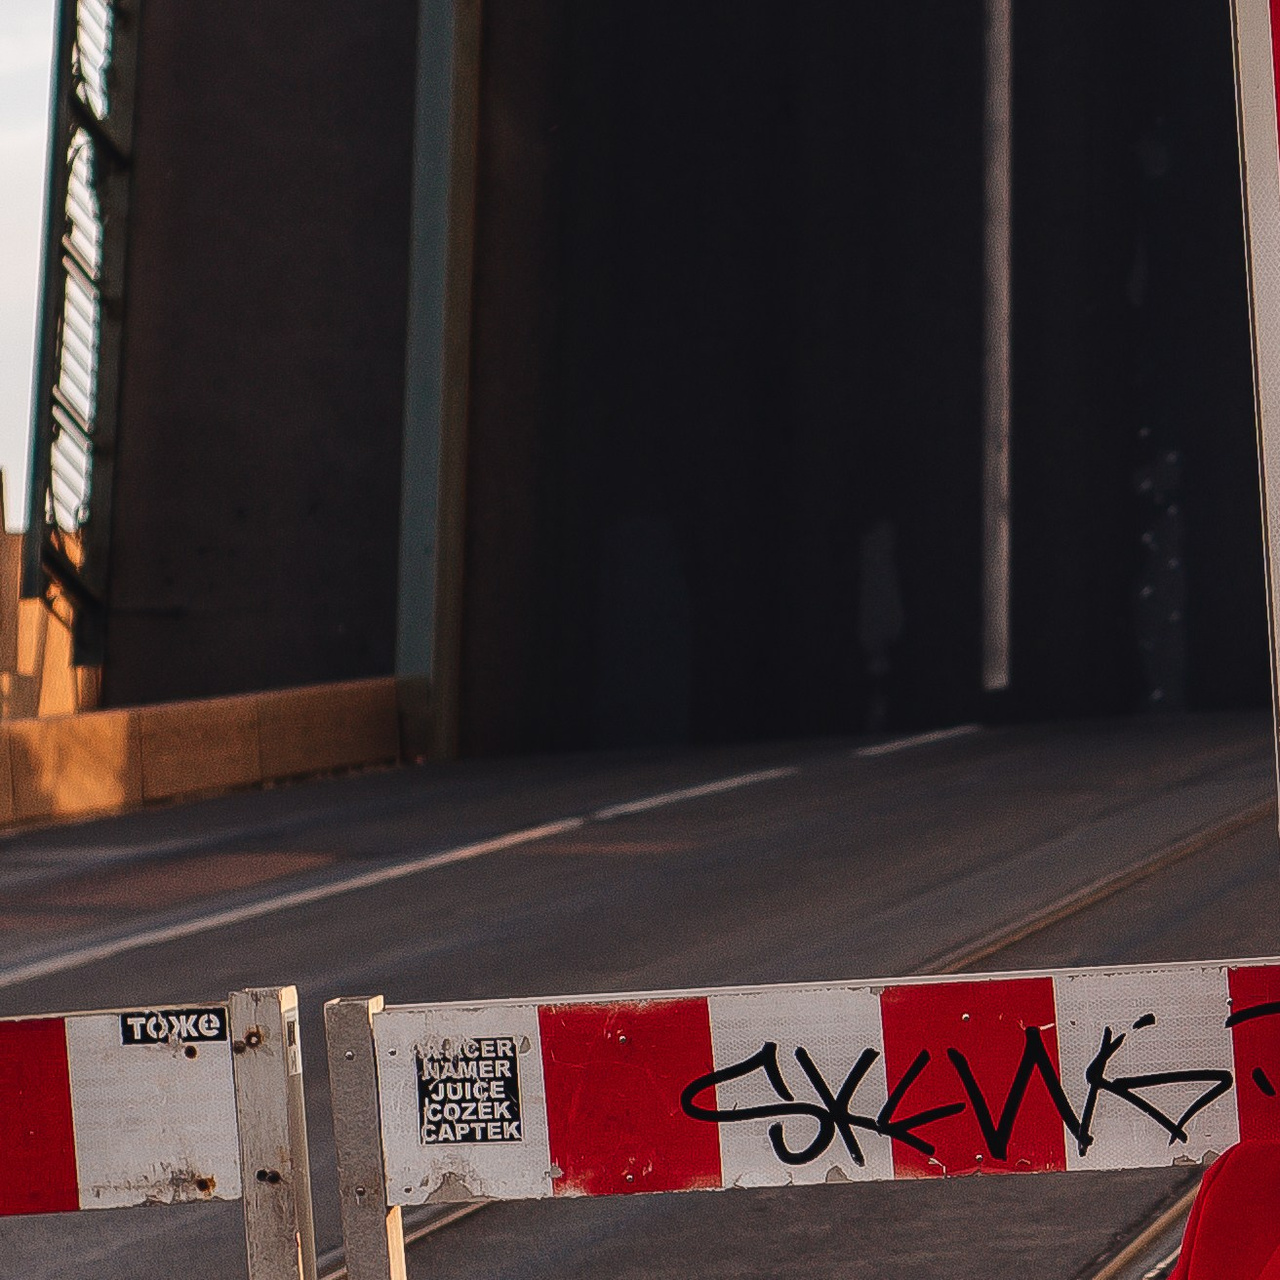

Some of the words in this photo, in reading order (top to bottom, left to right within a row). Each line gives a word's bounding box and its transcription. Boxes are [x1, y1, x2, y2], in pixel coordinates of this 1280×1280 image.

[430, 1080, 506, 1102] JUICE
[426, 1100, 512, 1121] COZEK
[421, 1121, 522, 1142] CAPTEK
